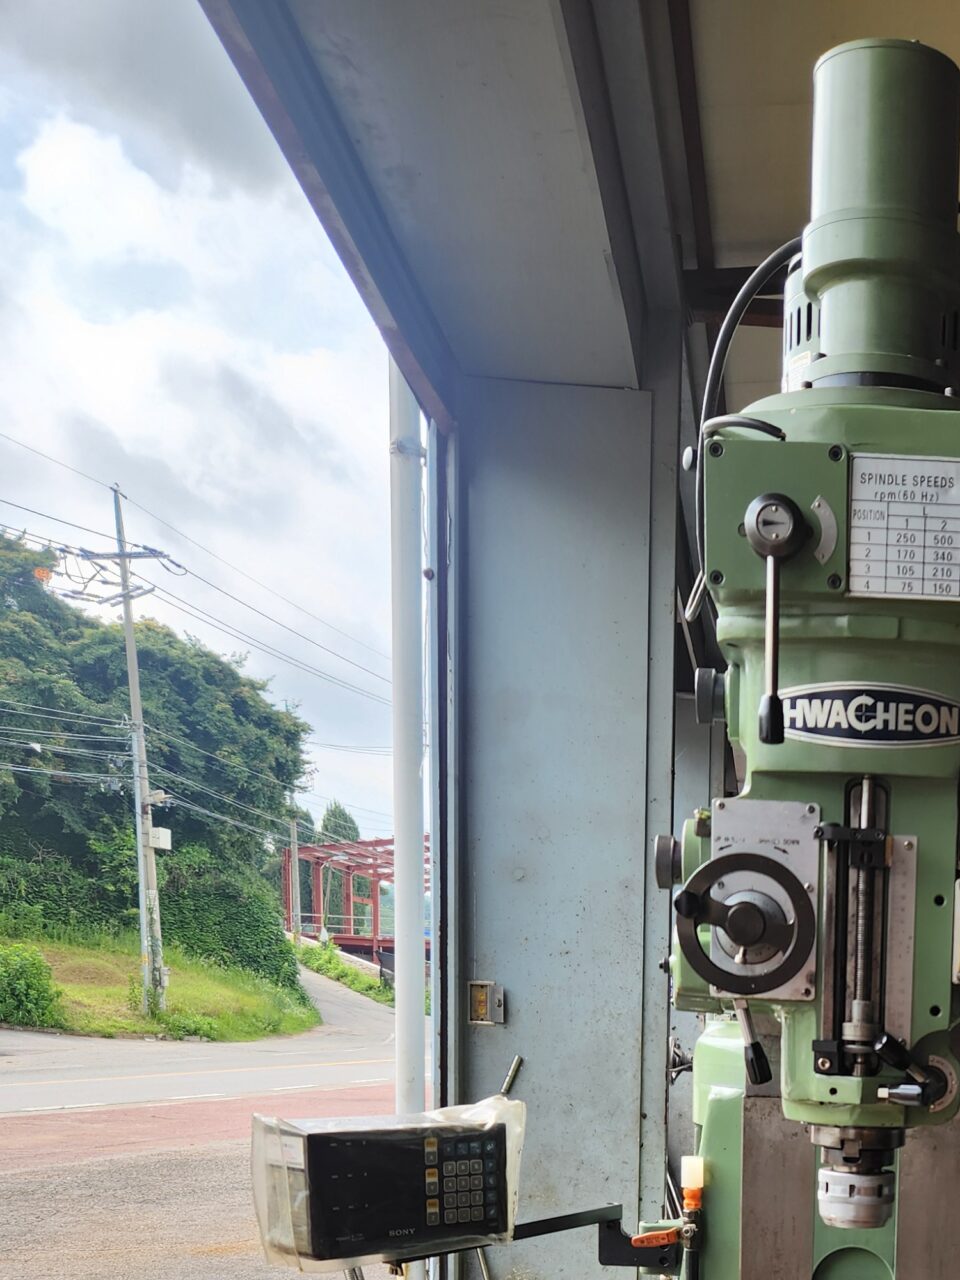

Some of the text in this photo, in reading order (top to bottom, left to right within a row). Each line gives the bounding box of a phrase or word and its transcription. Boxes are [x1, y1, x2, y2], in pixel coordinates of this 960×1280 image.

[860, 472, 954, 488] SPINDLE SPEEDS
[922, 506, 928, 516] L
[852, 508, 885, 521] POSITION
[940, 520, 947, 530] 2
[896, 532, 916, 543] 250
[933, 535, 954, 546] 500
[865, 548, 871, 558] 2
[897, 549, 915, 560] 170
[933, 551, 953, 562] 340
[865, 563, 871, 574] 3
[896, 565, 915, 576] 105
[932, 567, 952, 578] 210
[864, 580, 870, 590] 4
[901, 581, 914, 592] 75
[932, 583, 951, 594] 150
[783, 695, 959, 735] HWACHEON
[389, 1228, 416, 1236] SONY
